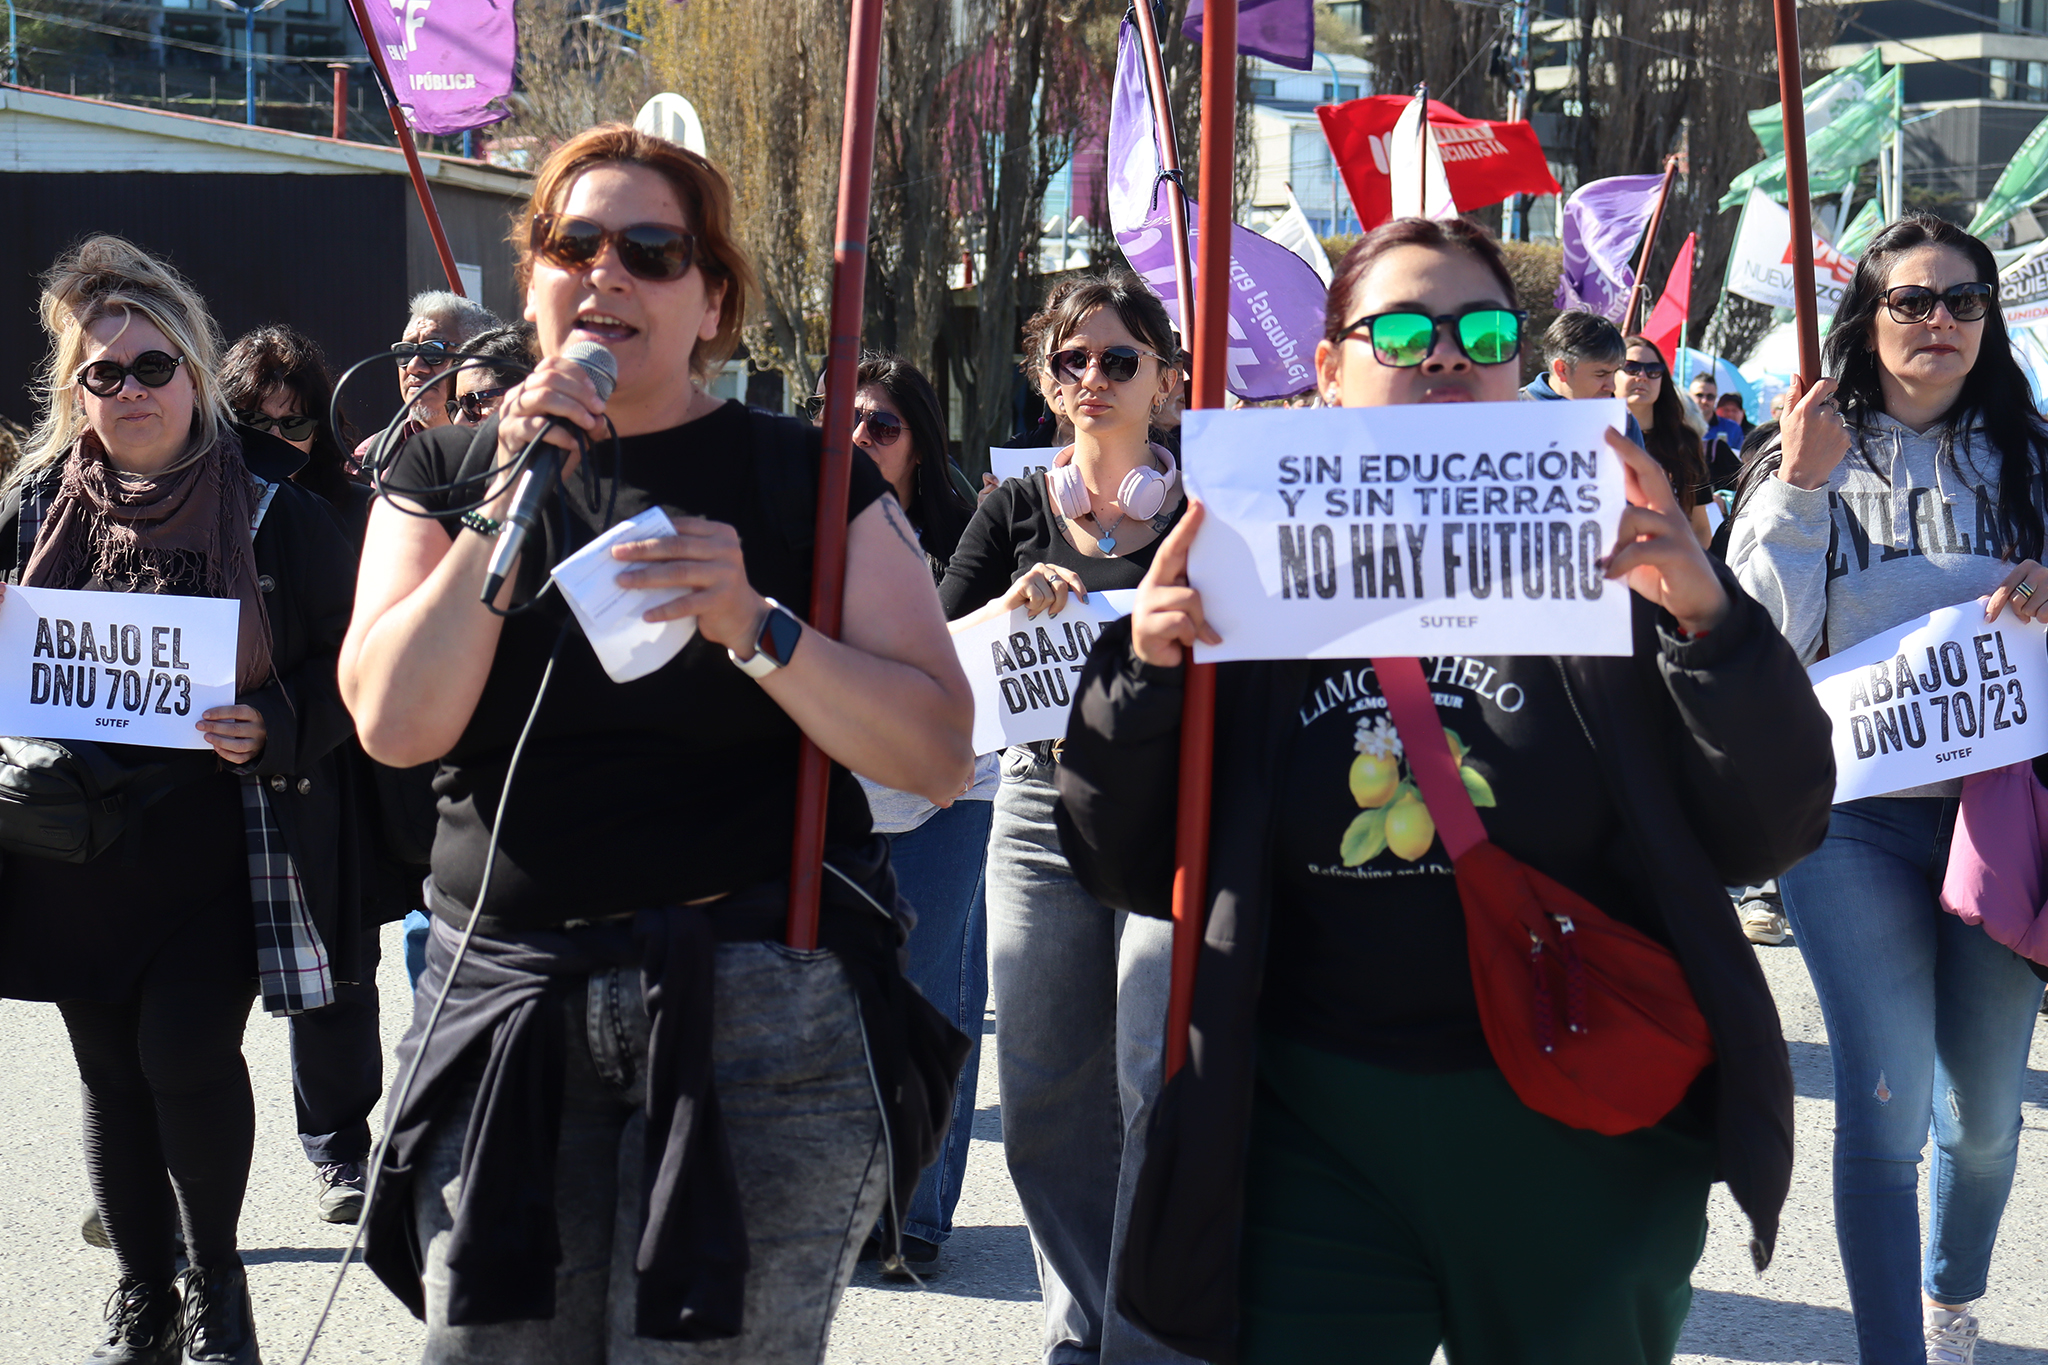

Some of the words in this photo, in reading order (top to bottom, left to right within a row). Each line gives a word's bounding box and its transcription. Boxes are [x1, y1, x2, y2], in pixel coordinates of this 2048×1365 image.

[416, 71, 477, 91] PÚBLICA
[1439, 138, 1510, 162] OCIALISTA
[1278, 454, 1342, 485] SIN
[1359, 441, 1597, 483] EDUCACIÓN
[1278, 489, 1306, 518] Y
[1325, 487, 1394, 518] SIN
[1412, 484, 1601, 516] TIERRAS
[1278, 523, 1338, 600] NO
[1349, 522, 1428, 600] HAY
[1441, 519, 1604, 601] FUTURO
[33, 616, 142, 667] ABAJO
[151, 626, 190, 670] EL
[1419, 615, 1479, 629] SUTEF
[990, 620, 1094, 676] ABAJO
[1850, 640, 1969, 712] ABAJO
[1972, 630, 2018, 682] EL
[30, 662, 97, 709] DNU
[105, 668, 192, 717] 70/23
[998, 667, 1071, 716] DNU
[95, 717, 130, 729] SUTEF
[1850, 701, 1927, 761] DNU
[1930, 678, 2029, 743] 70/23
[1935, 746, 1973, 764] SUTEF
